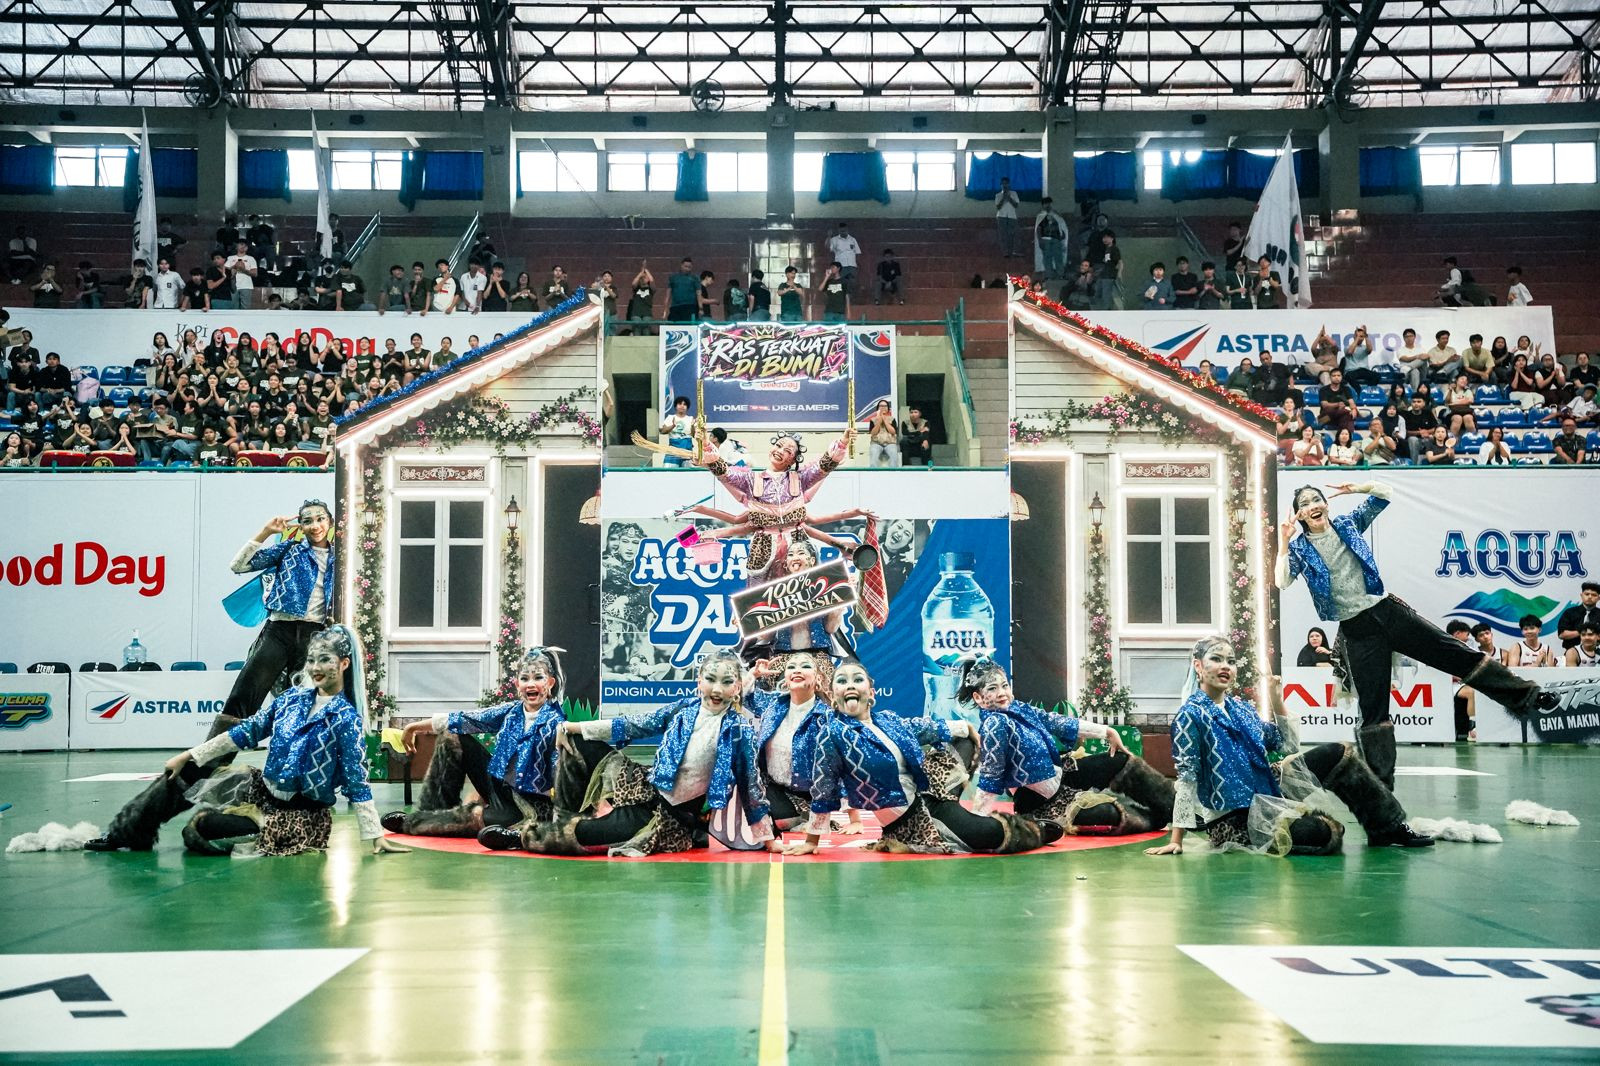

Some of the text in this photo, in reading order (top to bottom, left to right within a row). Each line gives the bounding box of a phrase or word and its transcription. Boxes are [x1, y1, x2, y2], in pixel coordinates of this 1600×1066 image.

[708, 335, 840, 367] RAS TERKUAT
[1216, 334, 1310, 353] ASTRA
[759, 353, 822, 378] BUMI
[713, 404, 749, 412] HOME
[771, 404, 840, 412] DREAMERS
[75, 541, 165, 597] Day
[1435, 528, 1588, 589] AQUA
[762, 572, 812, 608] 100%
[777, 585, 815, 610] IBU
[756, 590, 844, 629] INDONESIA
[931, 630, 987, 652] AQUA
[6, 694, 47, 705] CUMA
[604, 686, 699, 697] DINGIN ALAM
[133, 701, 191, 713] ASTRA
[1300, 714, 1328, 725] stra
[1389, 713, 1434, 726] Motor
[1540, 712, 1600, 731] GAYA MAKIN
